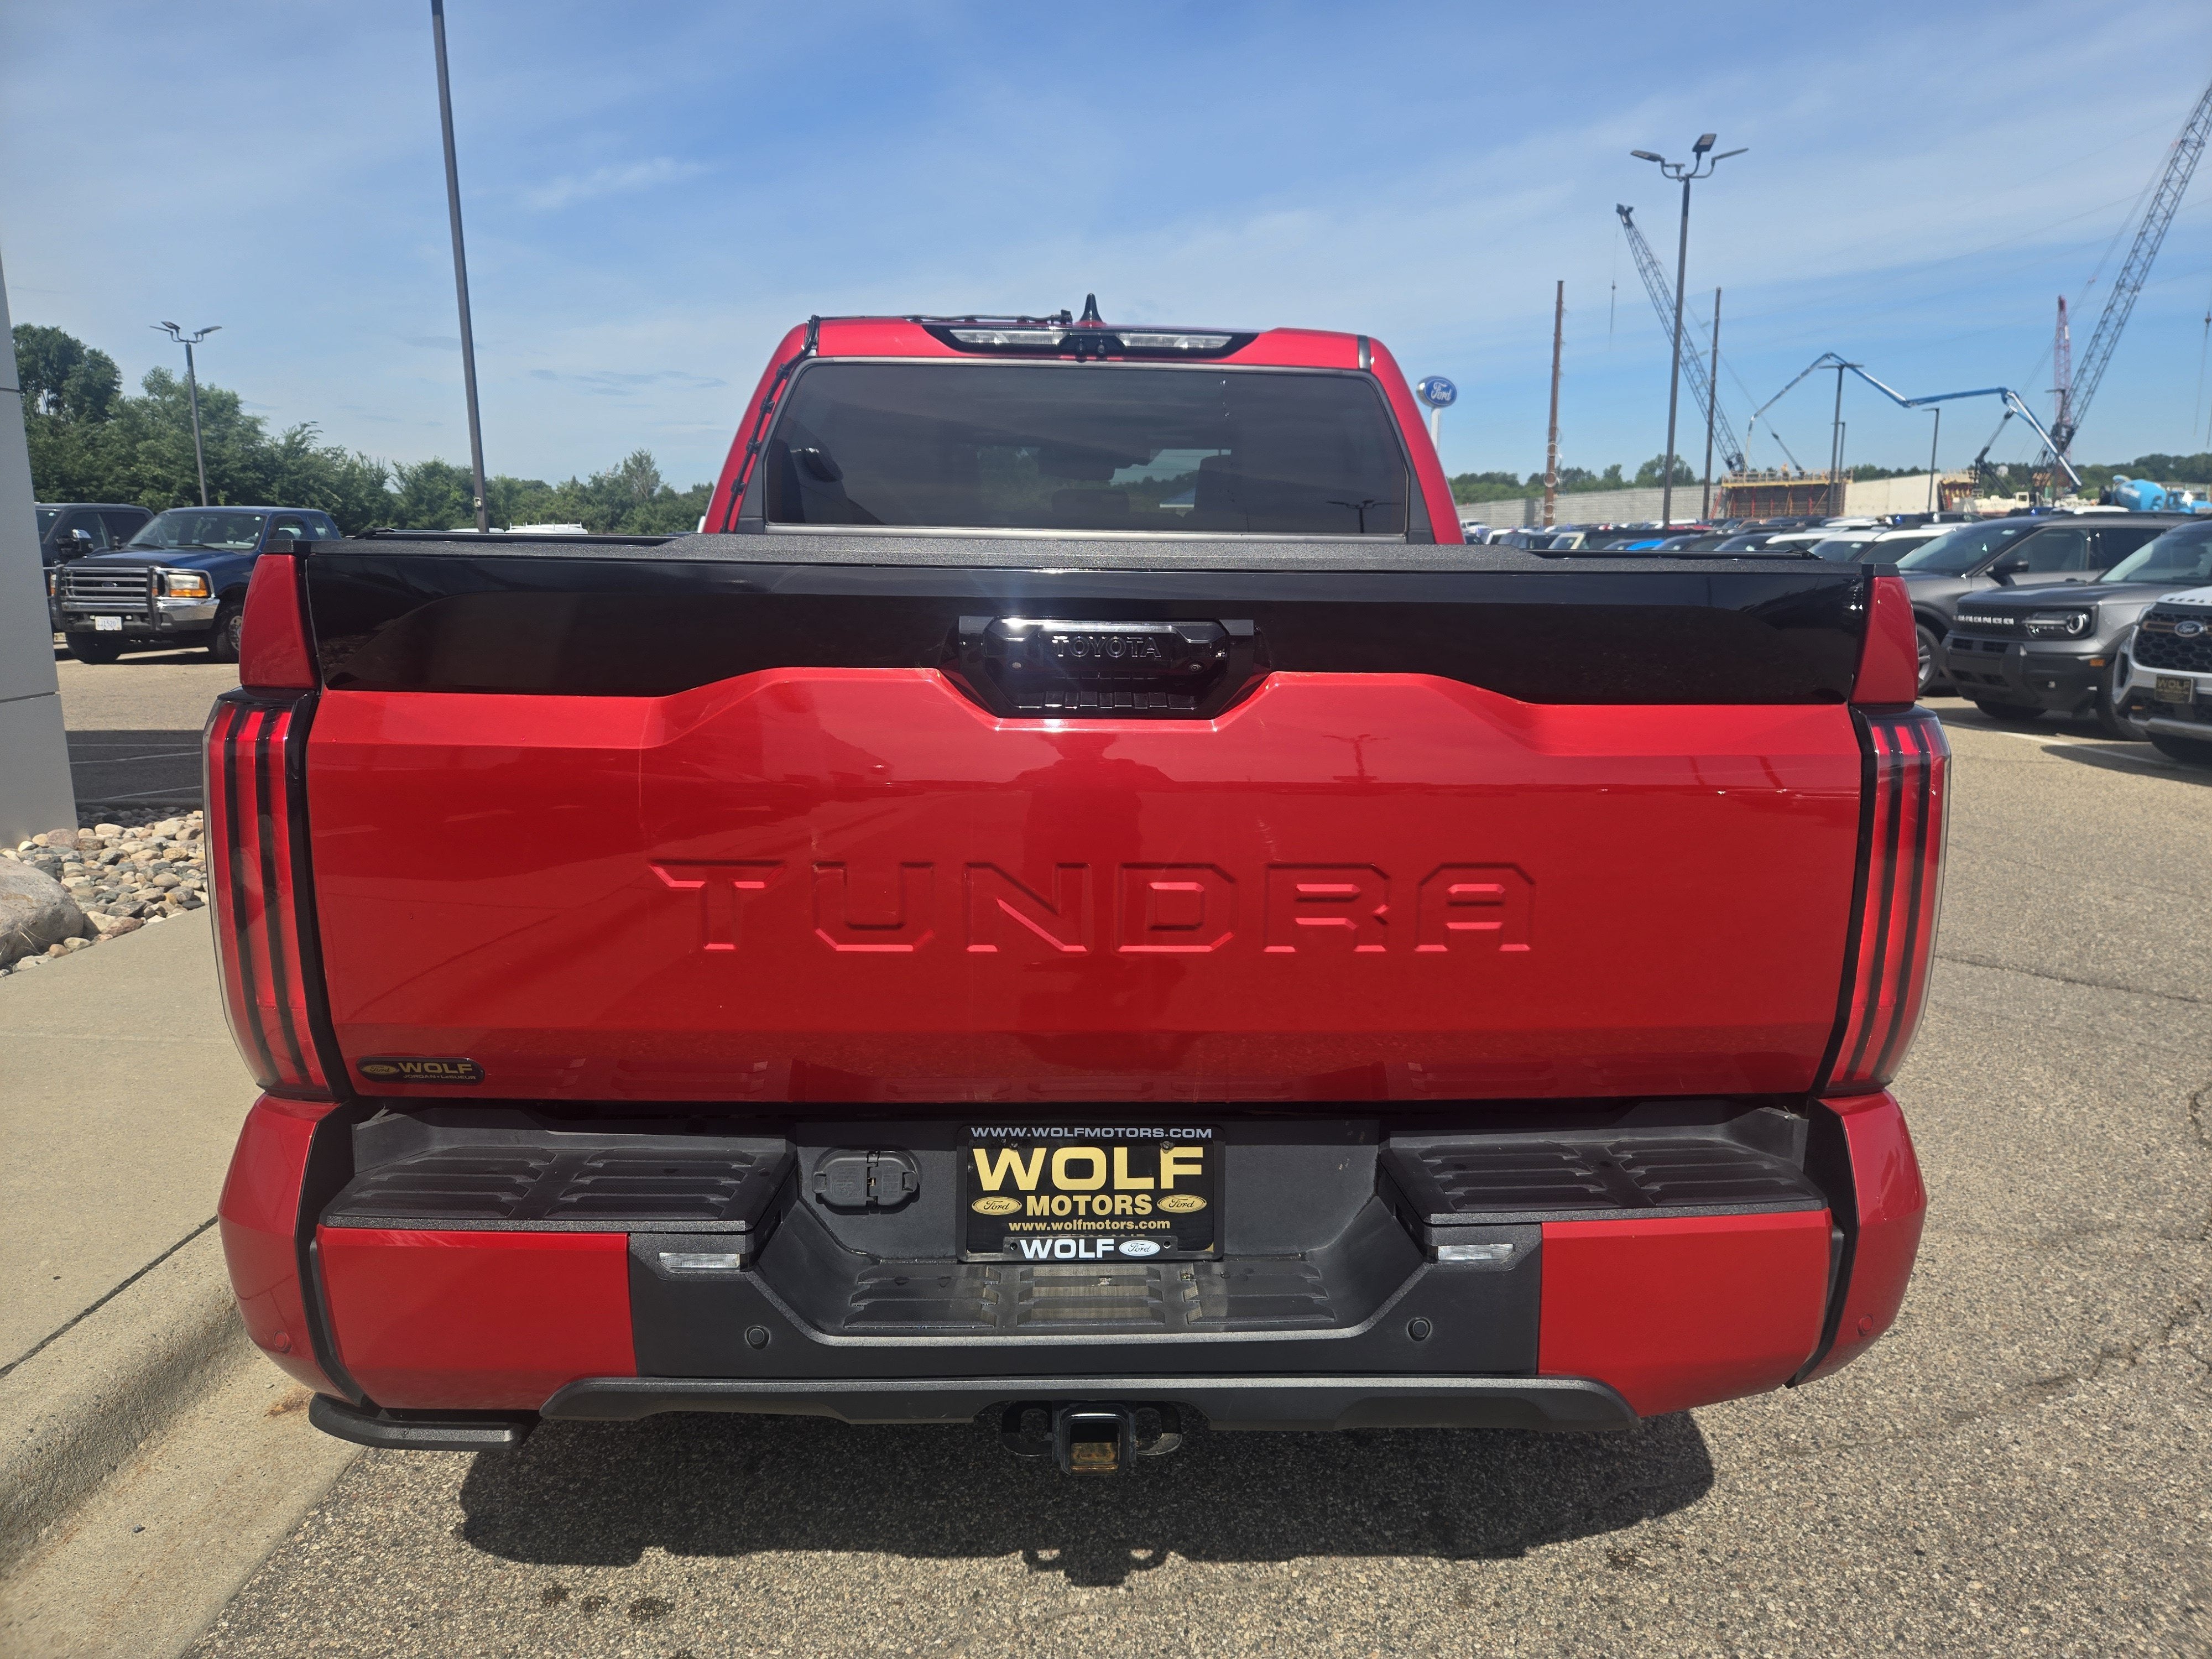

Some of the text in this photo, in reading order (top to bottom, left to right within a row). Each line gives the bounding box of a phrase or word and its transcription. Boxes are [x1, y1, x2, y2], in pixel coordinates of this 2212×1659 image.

[1431, 380, 1452, 401] Ford
[1052, 635, 1161, 658] TOYOTA
[648, 858, 1536, 953] TUNDRA
[398, 1062, 472, 1074] WOLF
[971, 1127, 1212, 1139] WWW.WOLFMOTORS.COM
[972, 1146, 1204, 1191] WOLF
[983, 1194, 1194, 1216] Ford MOTORS Ford
[1008, 1219, 1171, 1231] www.wolfmotors.com
[1020, 1238, 1151, 1259] WOLF Ford
